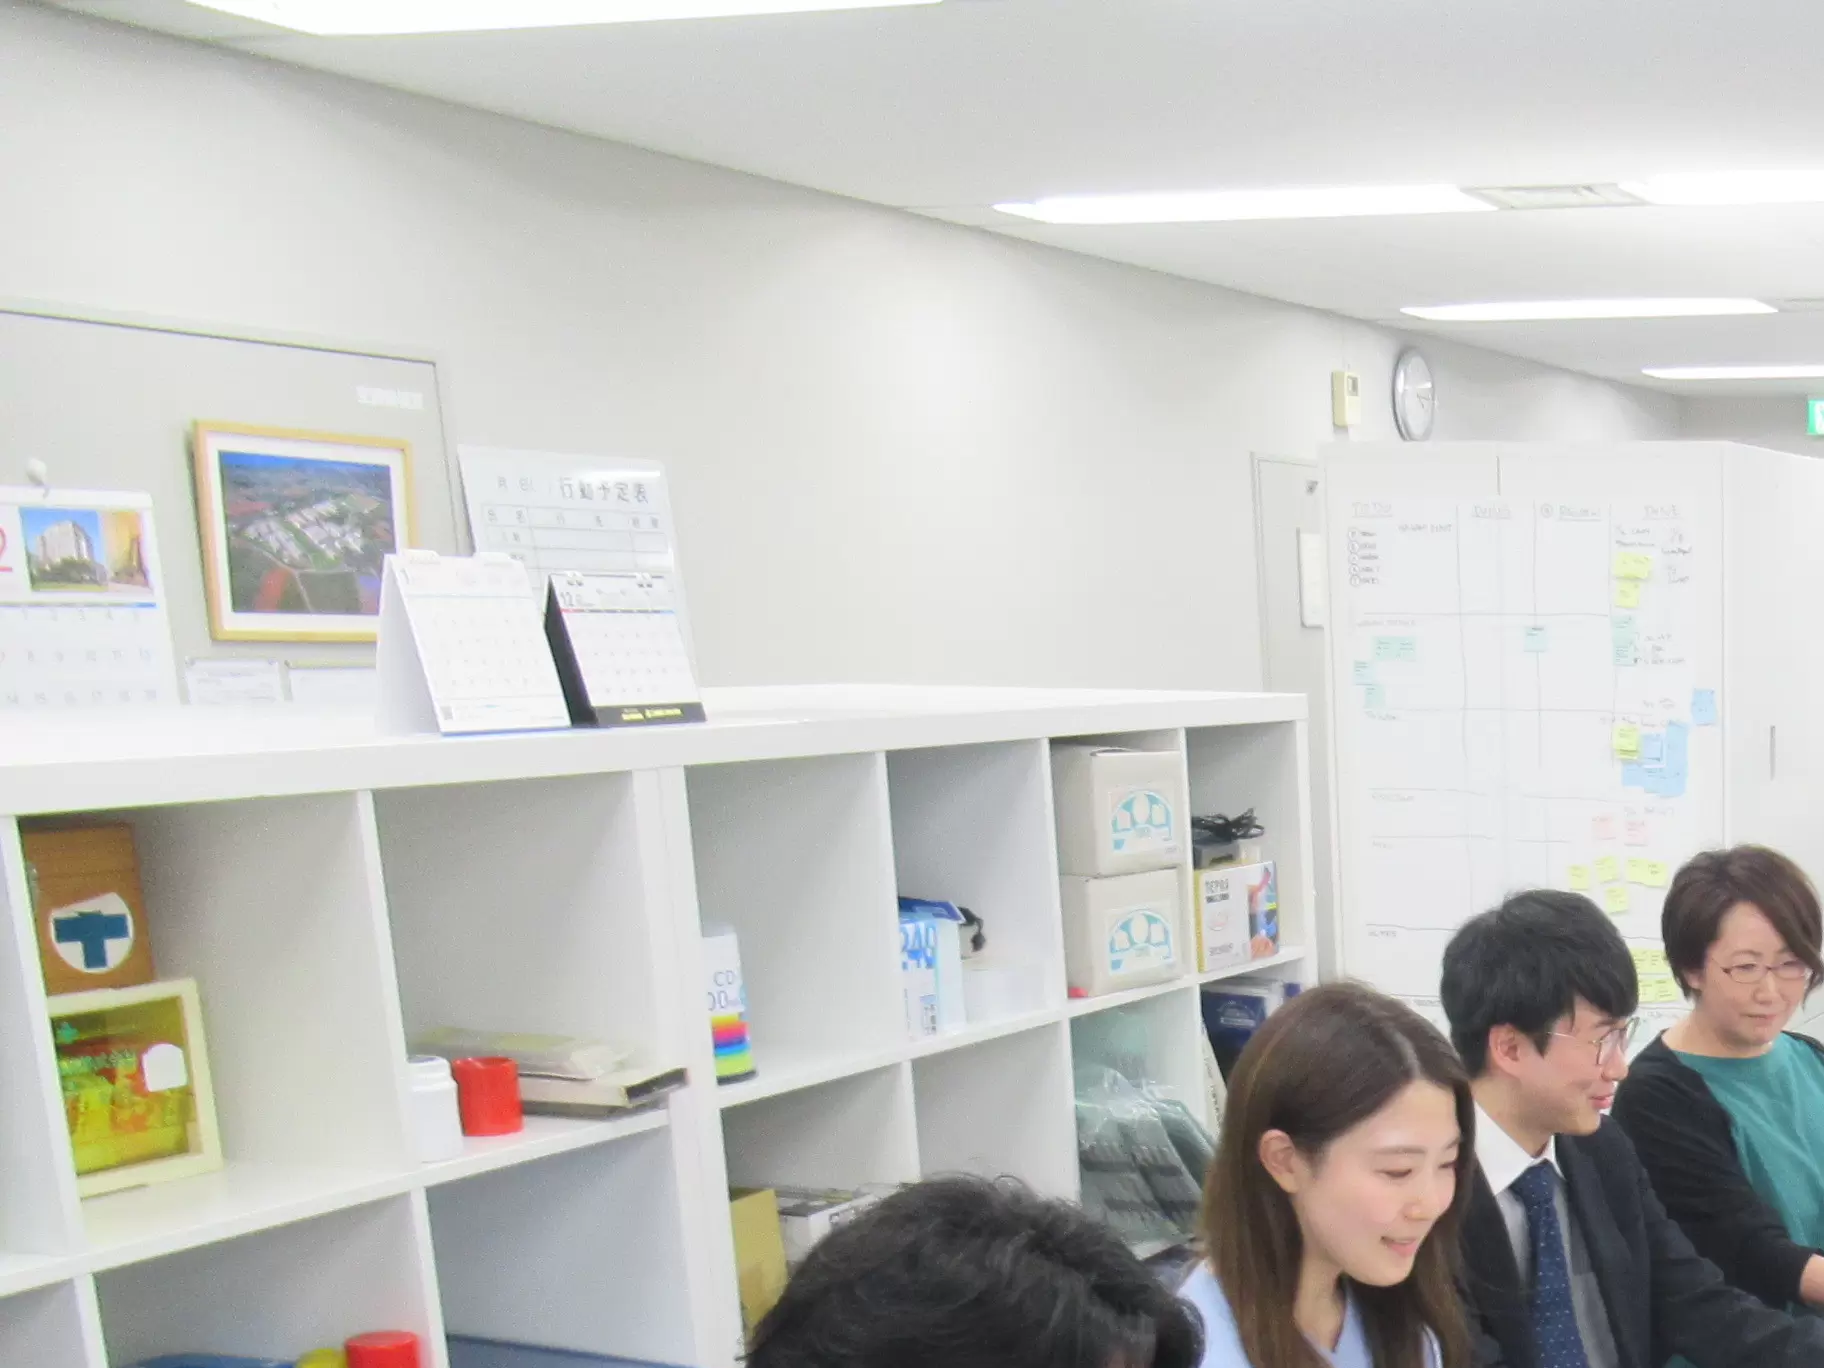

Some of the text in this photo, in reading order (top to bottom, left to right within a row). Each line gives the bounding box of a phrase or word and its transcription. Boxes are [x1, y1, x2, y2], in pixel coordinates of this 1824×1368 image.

[558, 476, 649, 504] 行動予定表
